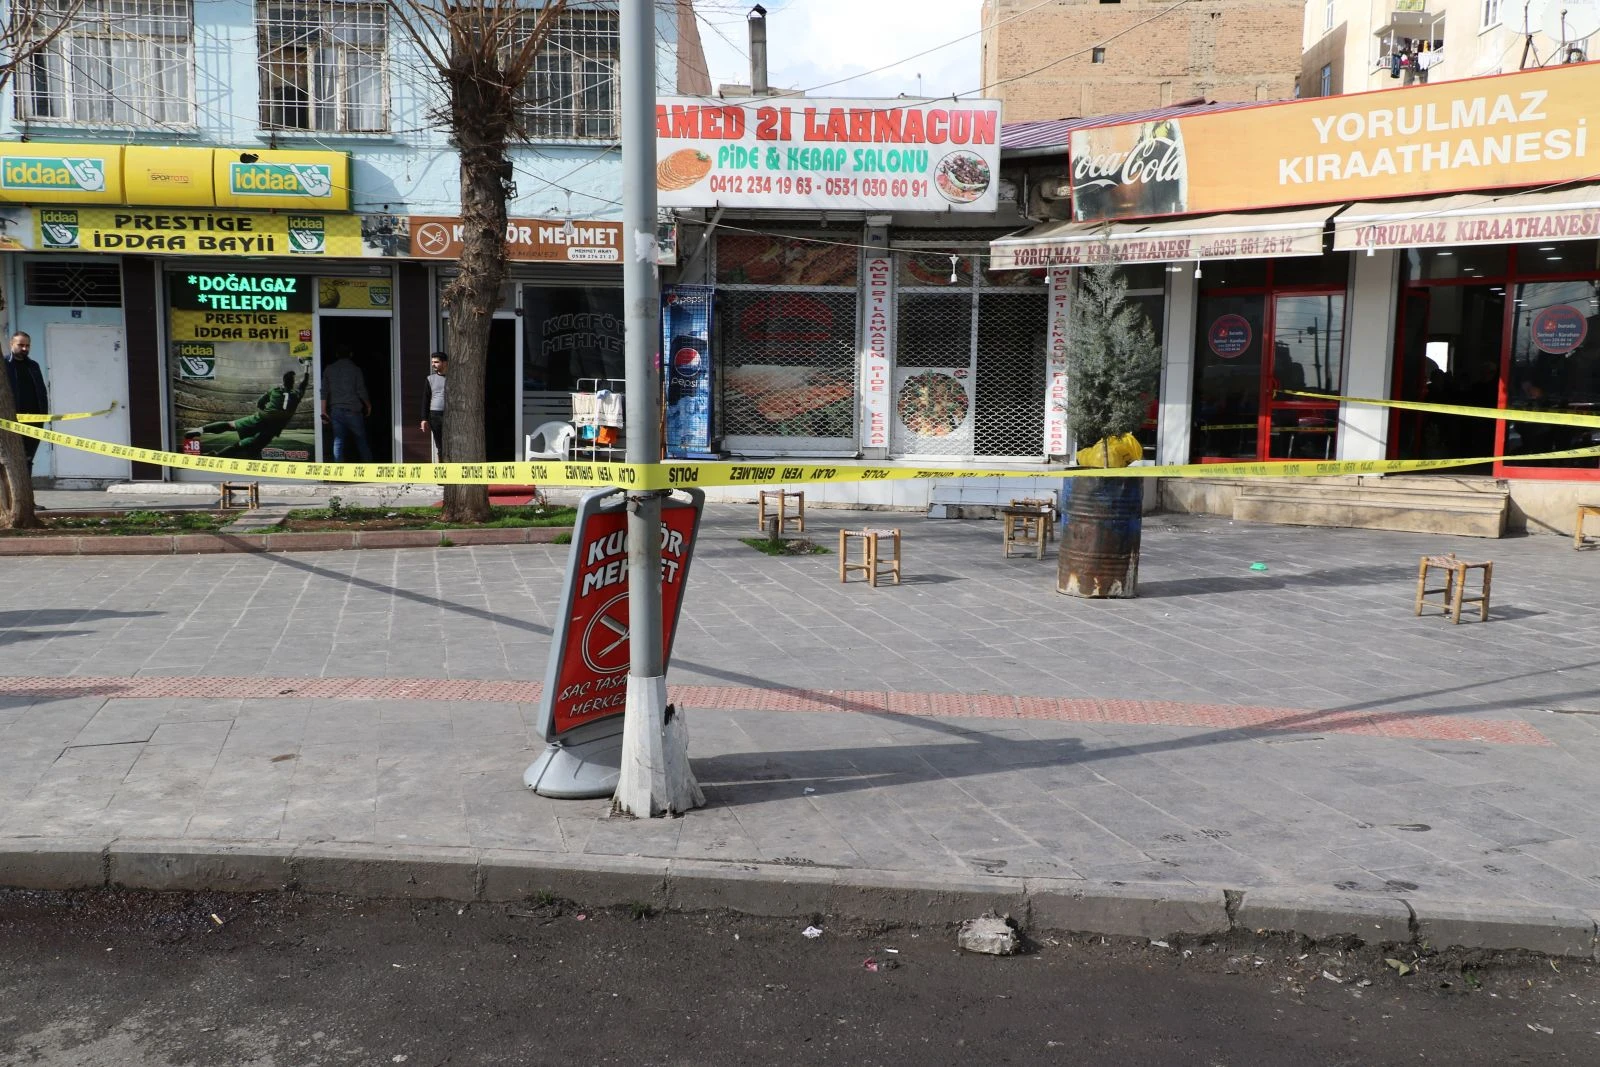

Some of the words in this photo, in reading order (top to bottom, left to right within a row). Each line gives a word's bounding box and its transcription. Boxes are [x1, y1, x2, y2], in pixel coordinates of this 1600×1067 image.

[656, 105, 745, 140] AMED
[804, 108, 997, 144] LAHMACUN
[1311, 88, 1548, 144] YORULMAZ
[765, 148, 780, 171] &
[787, 147, 847, 172] KEBAP
[853, 149, 929, 173] SALONU
[1277, 117, 1587, 185] KIRAATHANESİ
[6, 160, 71, 186] iddaa
[236, 167, 298, 191] iddaa
[710, 175, 743, 194] 0412
[747, 175, 771, 194] 234
[776, 176, 792, 194] 19
[796, 177, 812, 195] 63
[825, 177, 858, 196] 0531
[862, 178, 887, 197] 030
[891, 179, 908, 197] 60
[911, 179, 928, 198] 91
[41, 210, 77, 223] iddaa
[115, 213, 253, 231] PRESTİGE
[288, 217, 323, 229] iddaa
[94, 231, 186, 250] İDDAA
[539, 226, 618, 246] MEHMET
[1355, 221, 1449, 246] YORULMAZ
[1014, 246, 1081, 266] YORULMAZ
[870, 259, 888, 286] AMED
[1053, 269, 1069, 291] MED
[195, 324, 242, 339] İDDAA
[181, 344, 214, 356] iddaa
[618, 467, 635, 484] OLAY
[810, 468, 836, 480] OLAY
[581, 558, 679, 598] MEHET
